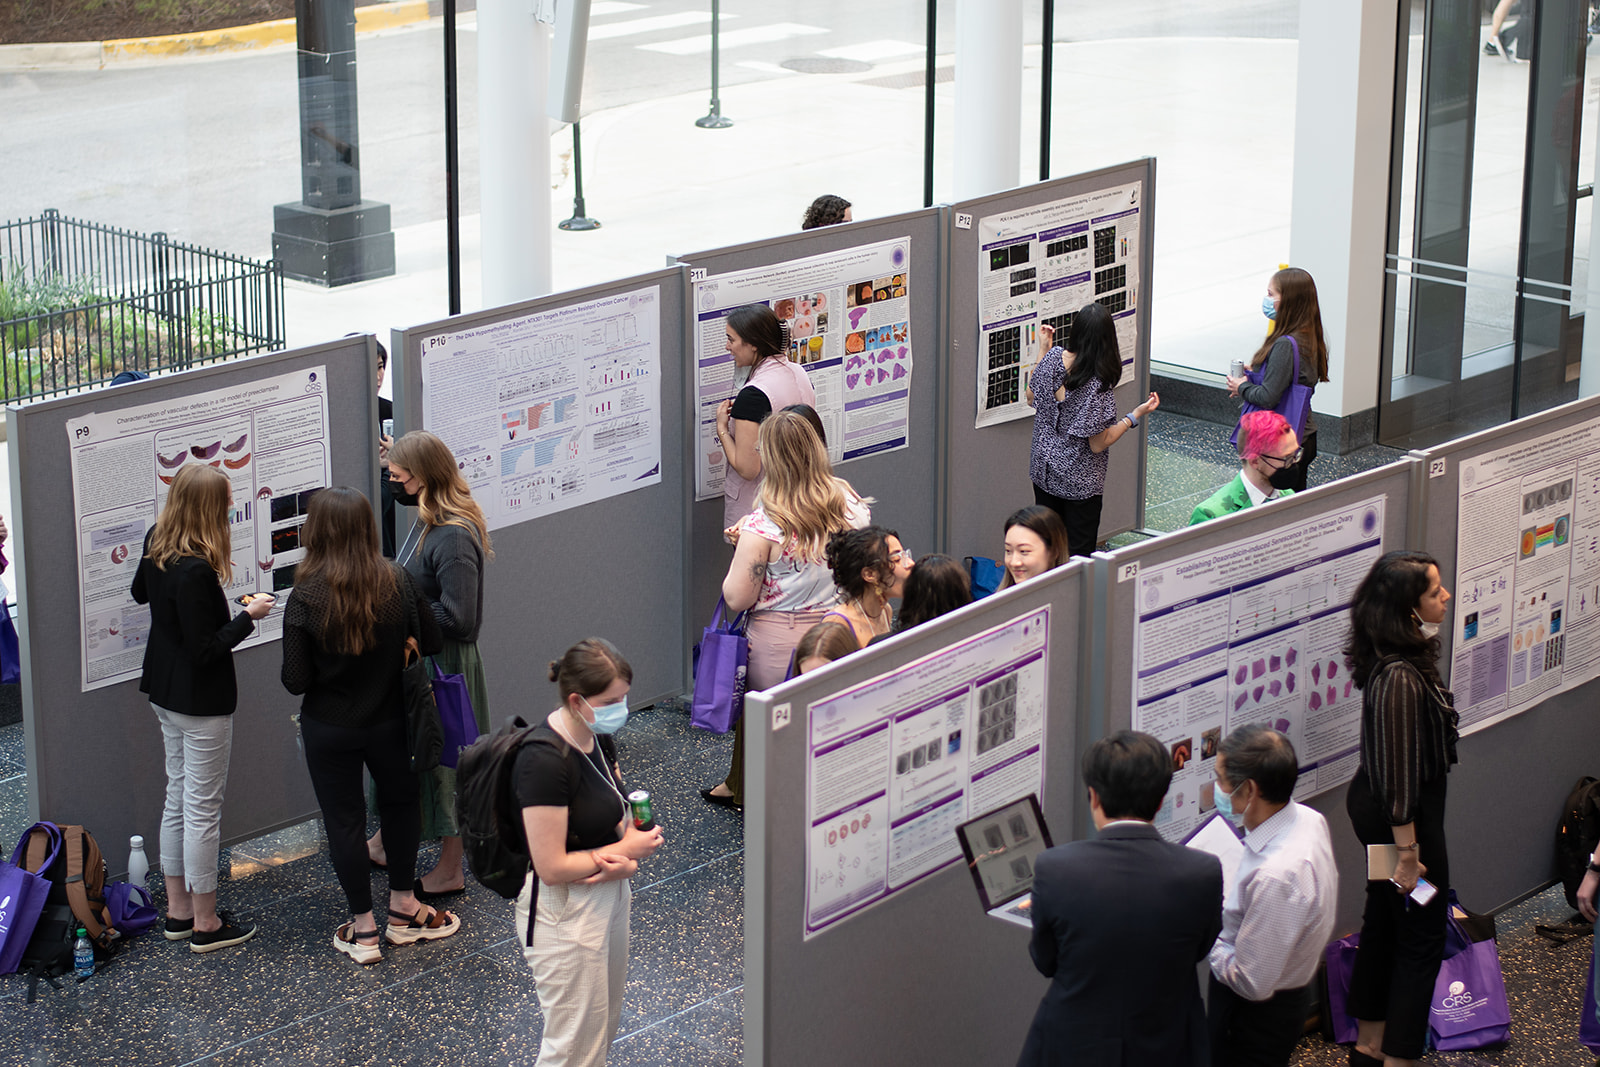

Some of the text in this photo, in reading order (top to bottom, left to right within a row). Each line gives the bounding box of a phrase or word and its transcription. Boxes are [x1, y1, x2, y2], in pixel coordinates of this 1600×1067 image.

[959, 216, 970, 225] P12
[430, 336, 446, 348] P10
[305, 382, 321, 392] CRS
[117, 411, 159, 425] Characterization
[167, 405, 189, 414] vascular
[190, 401, 209, 410] defects
[76, 426, 90, 439] P9
[1432, 462, 1443, 472] P2
[1176, 560, 1212, 575] Establishing
[1213, 541, 1270, 564] Doxorubicin-induced
[1271, 532, 1302, 546] Senescence
[1318, 520, 1337, 532] Human
[1338, 515, 1353, 524] Ovary
[1125, 564, 1137, 578] P3
[776, 708, 788, 723] P4
[1442, 992, 1472, 1008] CRS
